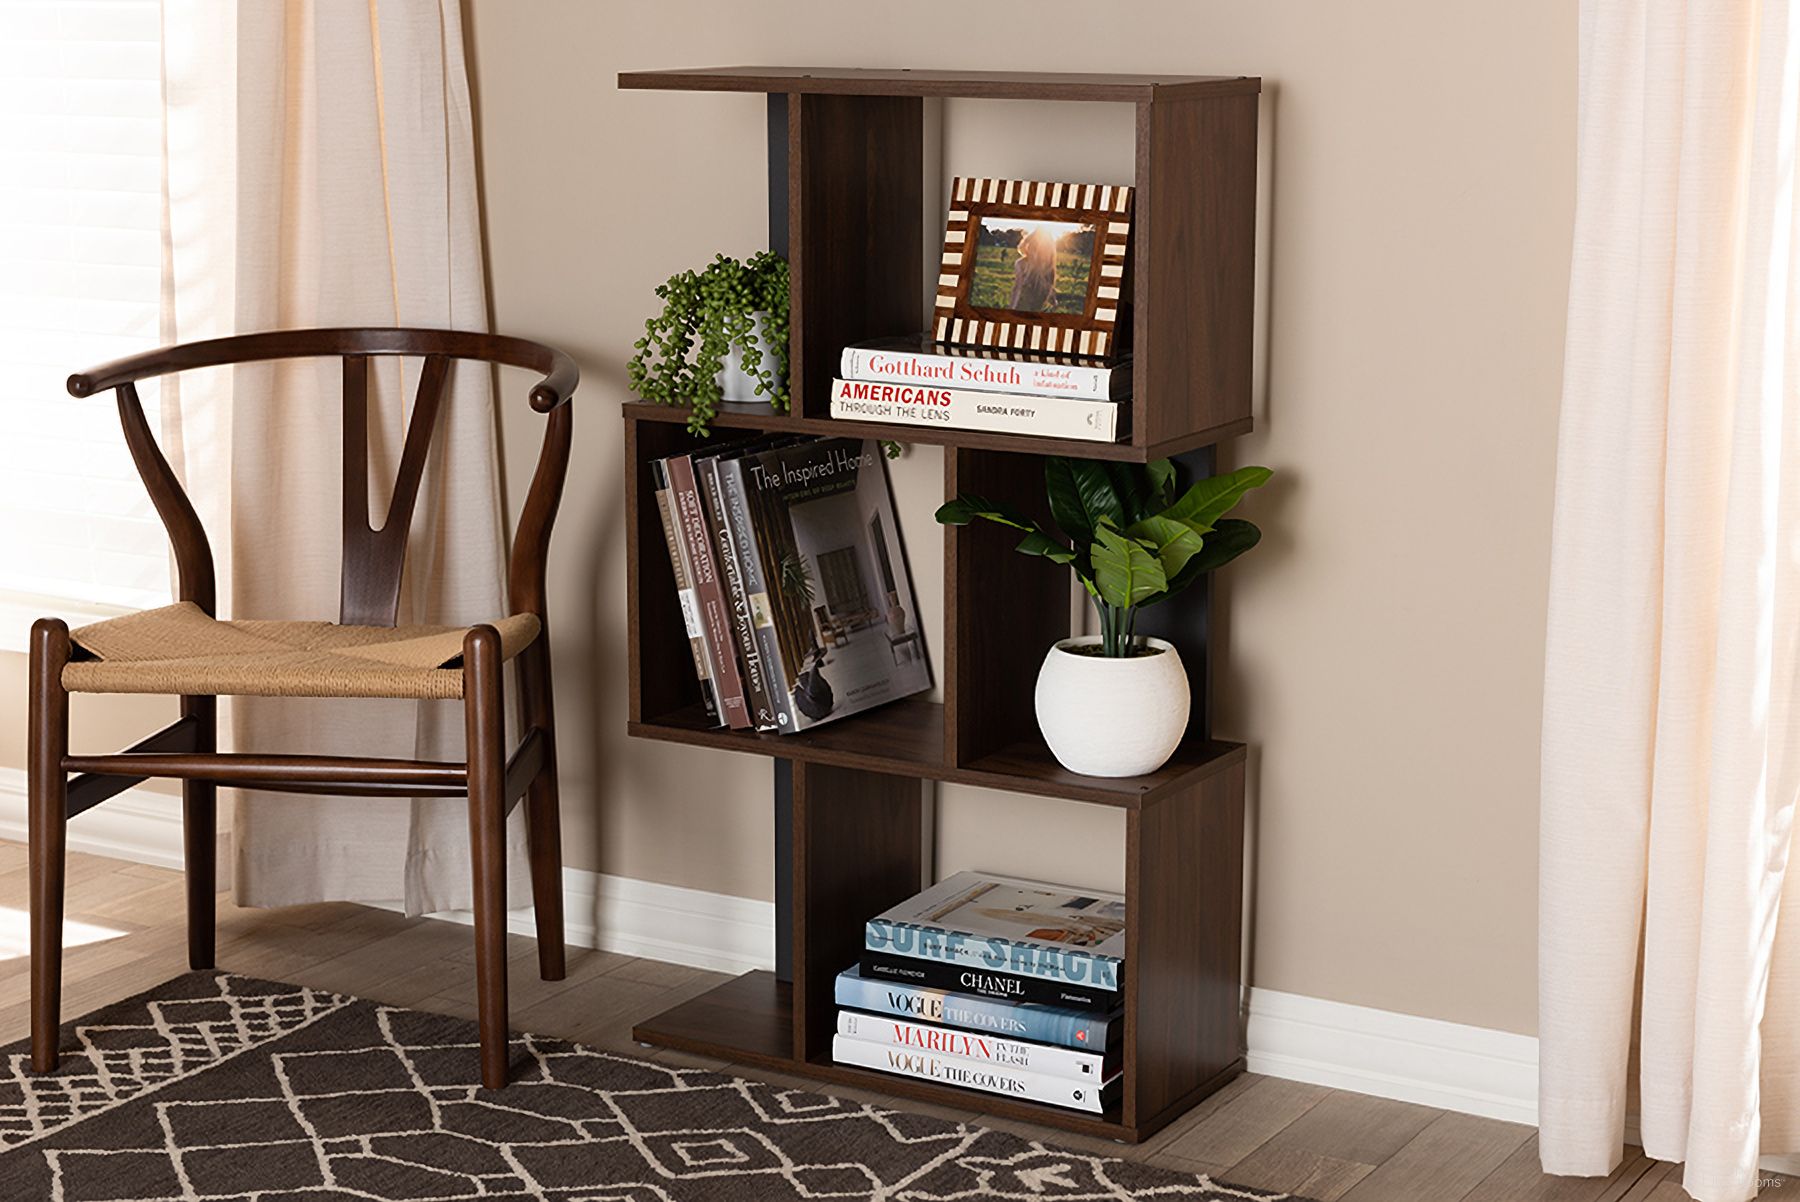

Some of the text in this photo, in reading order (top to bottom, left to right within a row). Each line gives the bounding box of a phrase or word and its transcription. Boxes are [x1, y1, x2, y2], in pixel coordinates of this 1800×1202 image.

[869, 355, 954, 380] Gotthard
[960, 362, 1021, 385] Schuh
[840, 383, 952, 407] AMERICANS
[840, 401, 950, 421] THROUGH THE LENS
[976, 404, 1036, 418] SANDRA FORTY
[750, 464, 780, 490] The
[781, 450, 835, 487] Inspired
[866, 918, 973, 960] SURF
[983, 938, 1120, 988] SHACK
[960, 972, 1025, 995] CHANEL
[888, 992, 1026, 1032] VOGUE THE COVERS
[893, 1024, 992, 1059] MARILYN
[888, 1051, 1026, 1092] VOGUE THE COVERS
